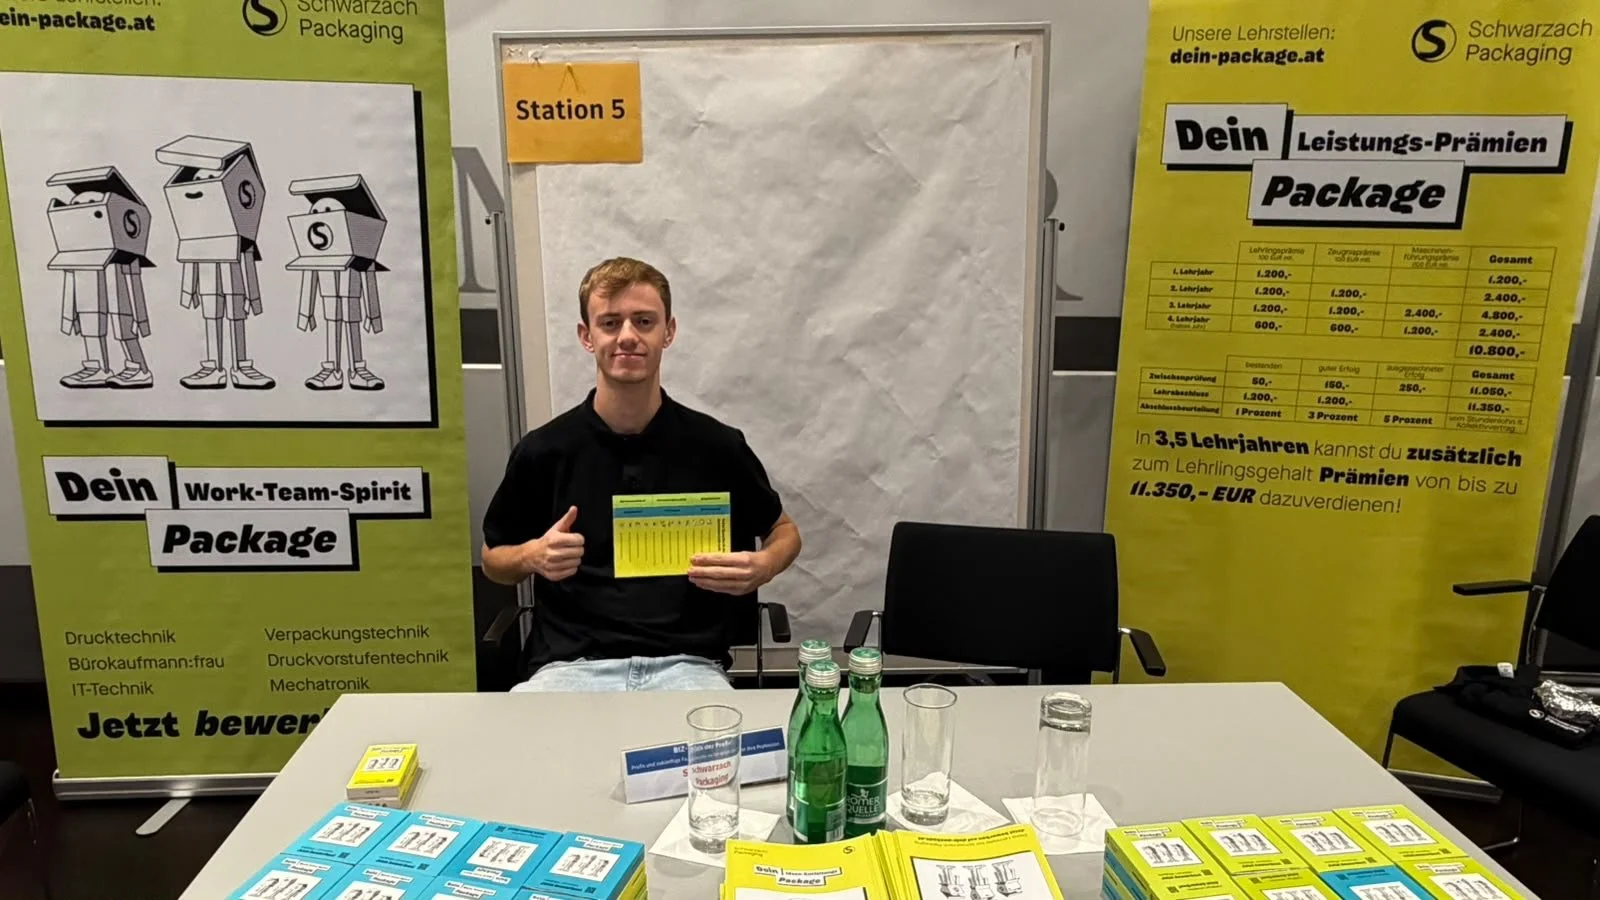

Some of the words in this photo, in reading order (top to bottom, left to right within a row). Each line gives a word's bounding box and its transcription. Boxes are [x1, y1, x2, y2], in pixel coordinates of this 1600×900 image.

[297, 0, 418, 15] Schwarzach
[0, 7, 156, 32] ein-package.at
[300, 18, 404, 45] Packaging
[1172, 26, 1233, 42] Unsere
[1237, 25, 1335, 42] Lehrstellen:
[1468, 19, 1593, 39] Schwarzach
[1170, 47, 1325, 66] dein-package.at
[1465, 43, 1573, 66] Packaging
[516, 99, 604, 121] Station
[611, 99, 626, 120] 5
[1175, 116, 1269, 152] Dein
[1297, 129, 1548, 155] Leistungs-Prämien
[1261, 175, 1447, 215] Package
[1489, 254, 1533, 265] Gesamt
[1180, 268, 1214, 276] Lehrjahr
[1257, 270, 1292, 280] 1.200,-
[1488, 275, 1527, 287] 1.200,-
[1179, 285, 1213, 294] Lehrjahr
[1255, 287, 1289, 297] 1.200,-
[1331, 289, 1367, 299] 1.200,-
[1484, 293, 1526, 304] 2.400,-
[1177, 302, 1212, 310] Lehrjahr
[1253, 304, 1288, 314] 1.200,-
[1329, 306, 1365, 317] 1.200,-
[1176, 315, 1211, 323] Lehrjahr
[1404, 309, 1442, 319] 2.400,-
[1481, 311, 1523, 323] 4.800,-
[1255, 321, 1283, 331] 600,-
[1330, 323, 1359, 334] 600,-
[1404, 327, 1439, 337] 1.200,-
[1479, 329, 1520, 340] 2.400,-
[1469, 345, 1526, 359] 10.800,-
[1149, 372, 1217, 383] Zwischenprüfung
[1472, 370, 1516, 381] Gesamt
[1252, 377, 1272, 387] 50,-
[1324, 380, 1350, 391] 150,-
[1153, 388, 1209, 397] Lehrabschluss
[1399, 383, 1426, 394] 250,-
[1470, 386, 1513, 398] 11.050,-
[1243, 393, 1278, 403] 1.200,-
[1317, 396, 1353, 406] 1.200,-
[1241, 408, 1282, 418] Prozent
[1467, 402, 1510, 414] 11.350,-
[1308, 411, 1316, 419] 3
[1317, 412, 1358, 423] Prozent
[1383, 415, 1390, 423] 5
[1392, 415, 1433, 425] Prozent
[1136, 430, 1151, 446] In
[1154, 430, 1187, 449] 3,5
[1191, 432, 1309, 458] Lehrjahren
[1314, 441, 1374, 460] kannst
[1379, 443, 1402, 460] du
[1407, 445, 1522, 467] zusätzlich
[1132, 459, 1169, 472] zum
[1176, 459, 1313, 484] Lehrlingsgehalt
[1319, 466, 1410, 487] Prämien
[1416, 476, 1450, 490] von
[1458, 474, 1487, 493] bis
[1494, 481, 1518, 495] zu
[55, 468, 159, 502] Dein
[185, 482, 412, 503] Work-Team-Spirit
[1130, 481, 1208, 503] 11.350,-
[1211, 486, 1256, 504] EUR
[1259, 490, 1401, 514] dazuverdienen!
[162, 524, 337, 558] Package
[65, 629, 176, 645] Drucktechnik
[264, 625, 430, 645] Verpackungstechnik
[69, 654, 225, 671] Bürokaufmann:frau
[267, 649, 449, 668] Druckvorstufentechnik
[72, 681, 154, 697] IT-Technik
[270, 676, 370, 693] Mechatronik
[77, 711, 181, 740] Jetzt
[195, 708, 330, 737] bewer
[778, 877, 821, 885] Package
